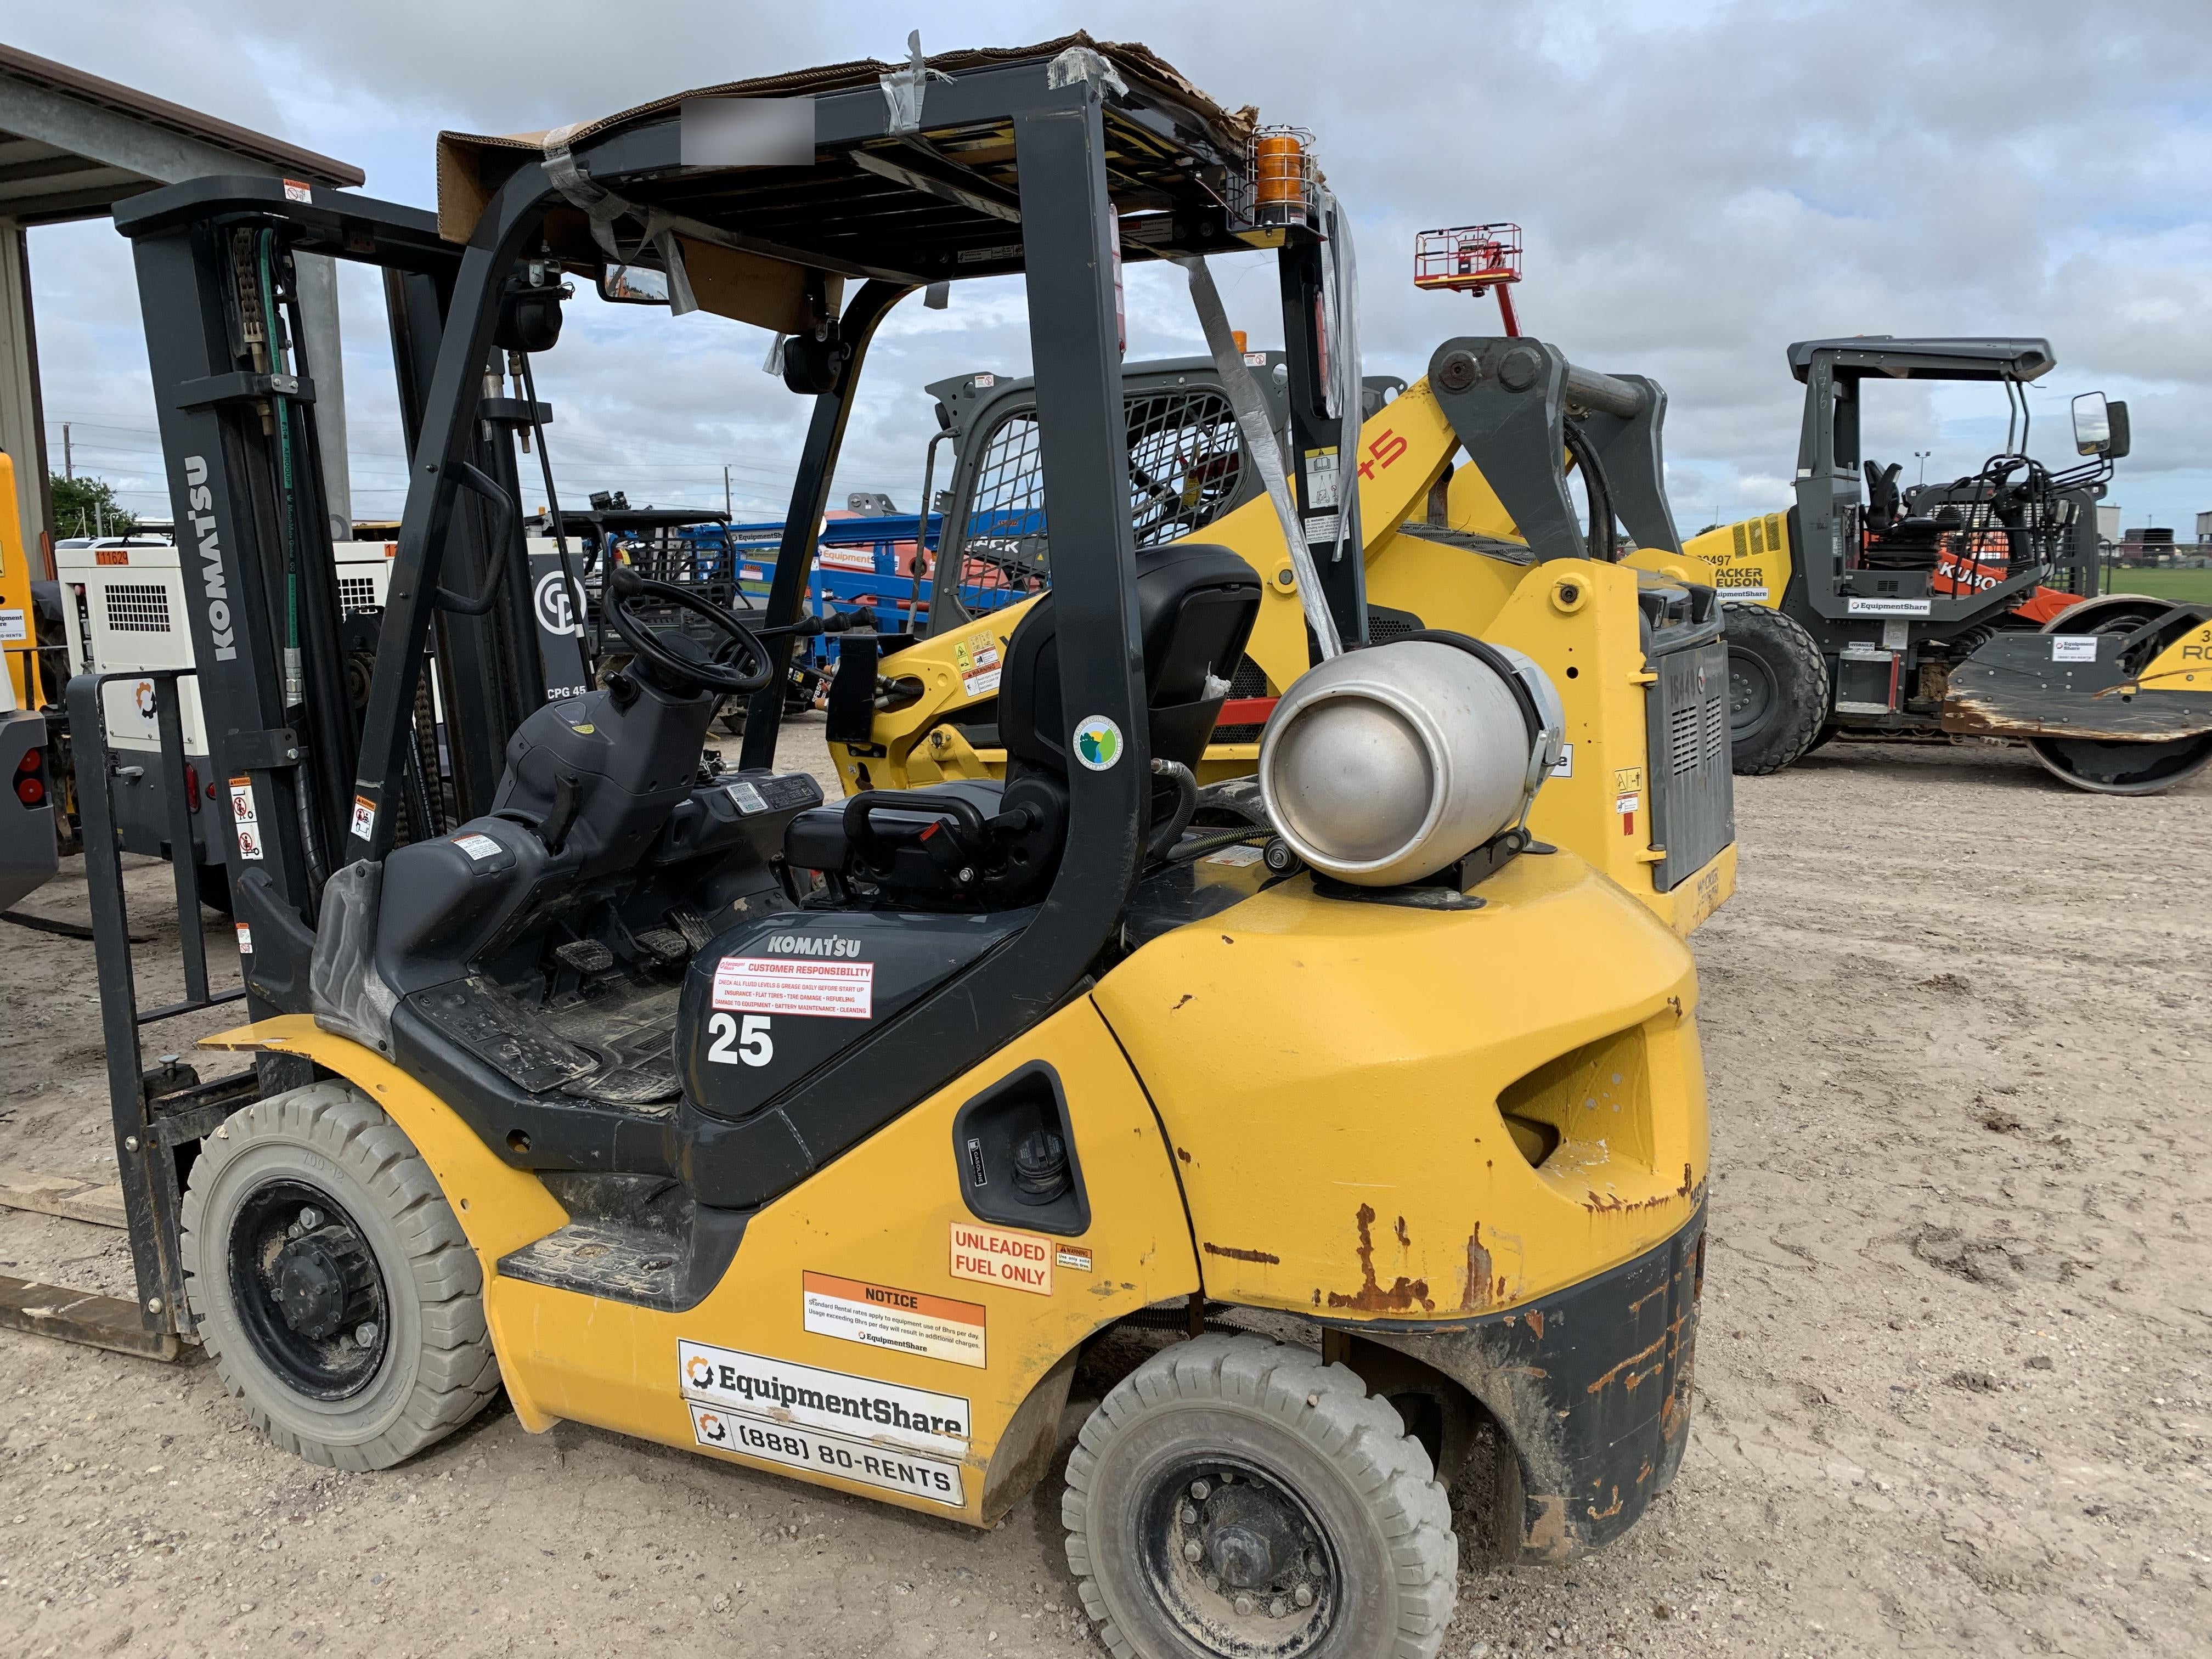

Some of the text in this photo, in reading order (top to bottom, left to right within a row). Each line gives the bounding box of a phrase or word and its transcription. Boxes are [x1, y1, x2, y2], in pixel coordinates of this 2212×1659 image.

[284, 447, 292, 486] AEROQUIP
[738, 532, 783, 541] EquipmentSh
[97, 551, 128, 565] 111629
[185, 455, 237, 662] KOMATSU
[1716, 568, 1763, 578] ACKER
[1939, 561, 2002, 590] KUBO
[973, 664, 996, 677] WARNING
[548, 685, 586, 699] CPG 45
[1084, 716, 1119, 734] TECHNOLOGY
[1081, 758, 1096, 769] TODAY
[1108, 738, 1121, 766] TOMORROW
[767, 934, 861, 958] KOMATSU
[748, 963, 871, 977] CUSTOMER RESPONSIBILITY
[708, 1012, 774, 1067] 25
[974, 1151, 984, 1184] GASOLINE
[956, 1231, 1045, 1261] UNLEADED
[1066, 1247, 1088, 1257] WARNING
[956, 1254, 1045, 1285] FUEL ONLY
[866, 1287, 918, 1310] NOTICE
[809, 1299, 833, 1309] Standard
[834, 1305, 852, 1313] Rental
[868, 1312, 884, 1322] apply
[892, 1317, 922, 1328] equipment
[943, 1327, 956, 1335] 8hrs
[968, 1332, 980, 1340] day.
[809, 1308, 826, 1317] Usage
[826, 1313, 854, 1324] exceeding
[879, 1323, 889, 1331] day
[901, 1328, 917, 1336] result
[925, 1333, 955, 1344] additional
[955, 1339, 980, 1350] charges.
[866, 1333, 928, 1352] EquipmentShare
[719, 1364, 962, 1437] EquipmentShare
[739, 1425, 951, 1492] (888) 80-RENTS
